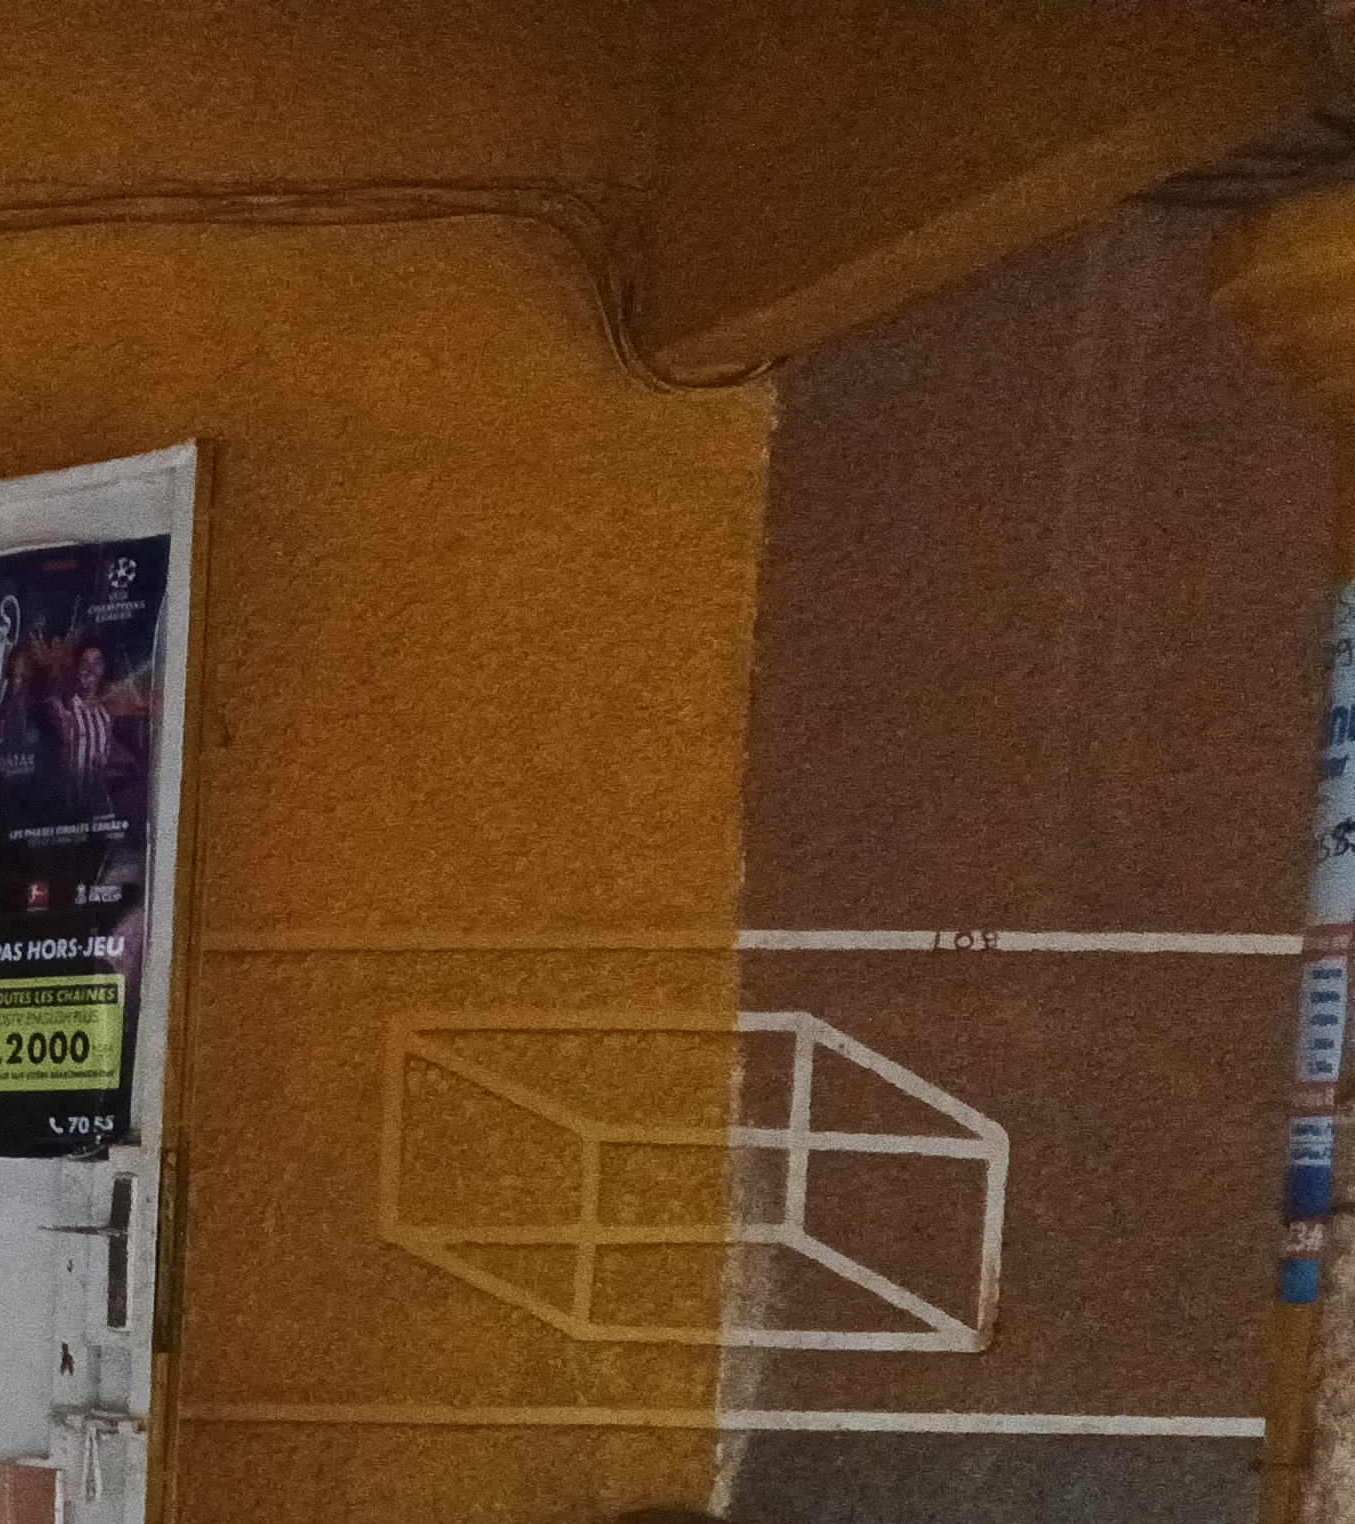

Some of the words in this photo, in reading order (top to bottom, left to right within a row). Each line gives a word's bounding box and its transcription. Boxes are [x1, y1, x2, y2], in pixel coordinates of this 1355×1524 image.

[27, 936, 125, 961] HORS-JEU
[34, 991, 54, 1005] LES
[68, 1115, 90, 1134] 70
